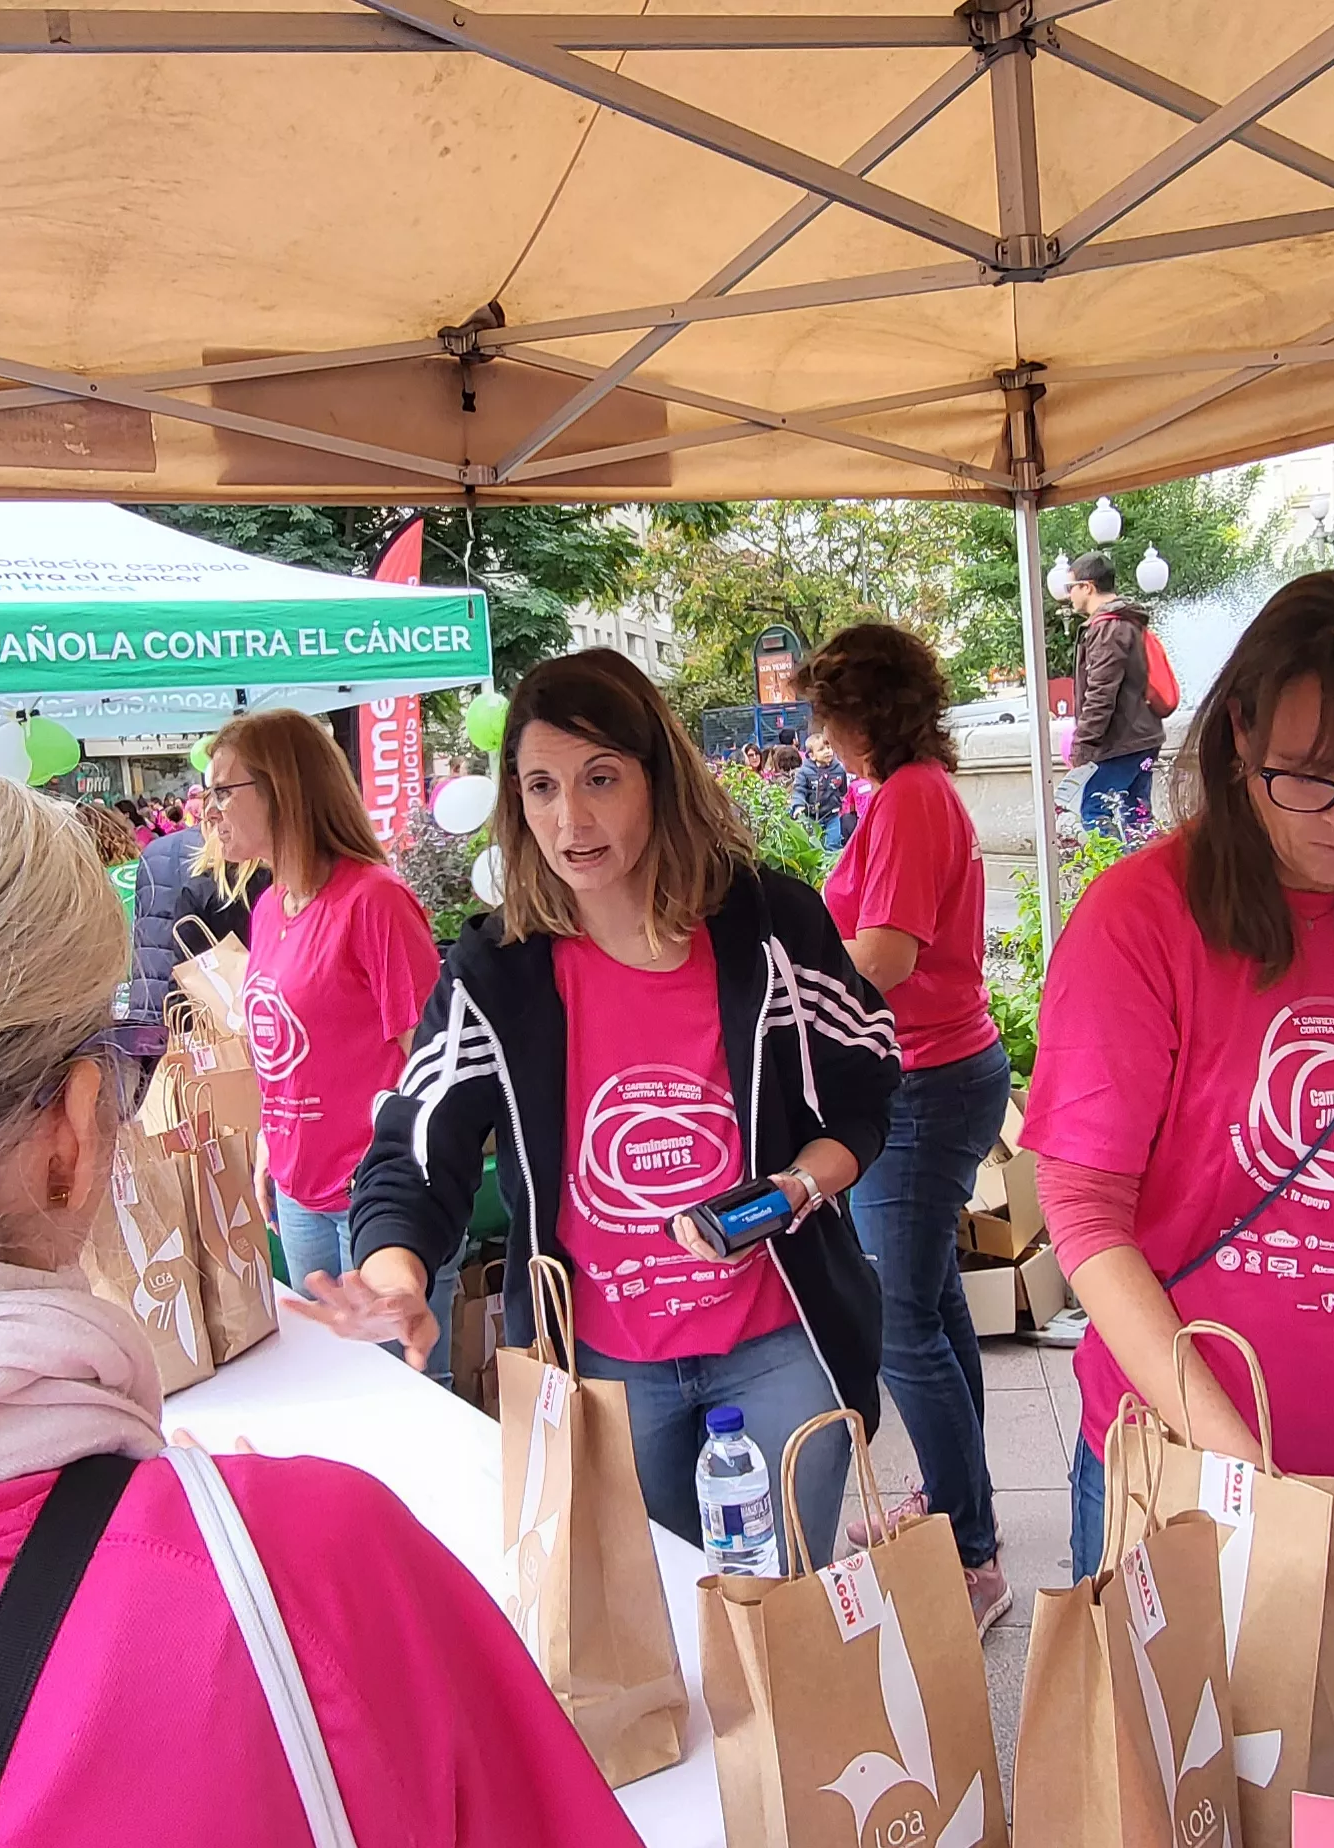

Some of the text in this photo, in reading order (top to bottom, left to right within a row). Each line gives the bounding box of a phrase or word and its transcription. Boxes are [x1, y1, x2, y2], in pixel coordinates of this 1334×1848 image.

[71, 571, 101, 583] el
[106, 570, 203, 584] cáncer
[125, 559, 251, 576] española
[142, 628, 293, 661] CONTRA
[298, 627, 340, 656] EL
[344, 620, 472, 655] CÁNCER
[1300, 1026, 1334, 1035] CONTRA
[625, 1135, 694, 1156] Caminemos
[632, 1148, 692, 1171] JUNTOS
